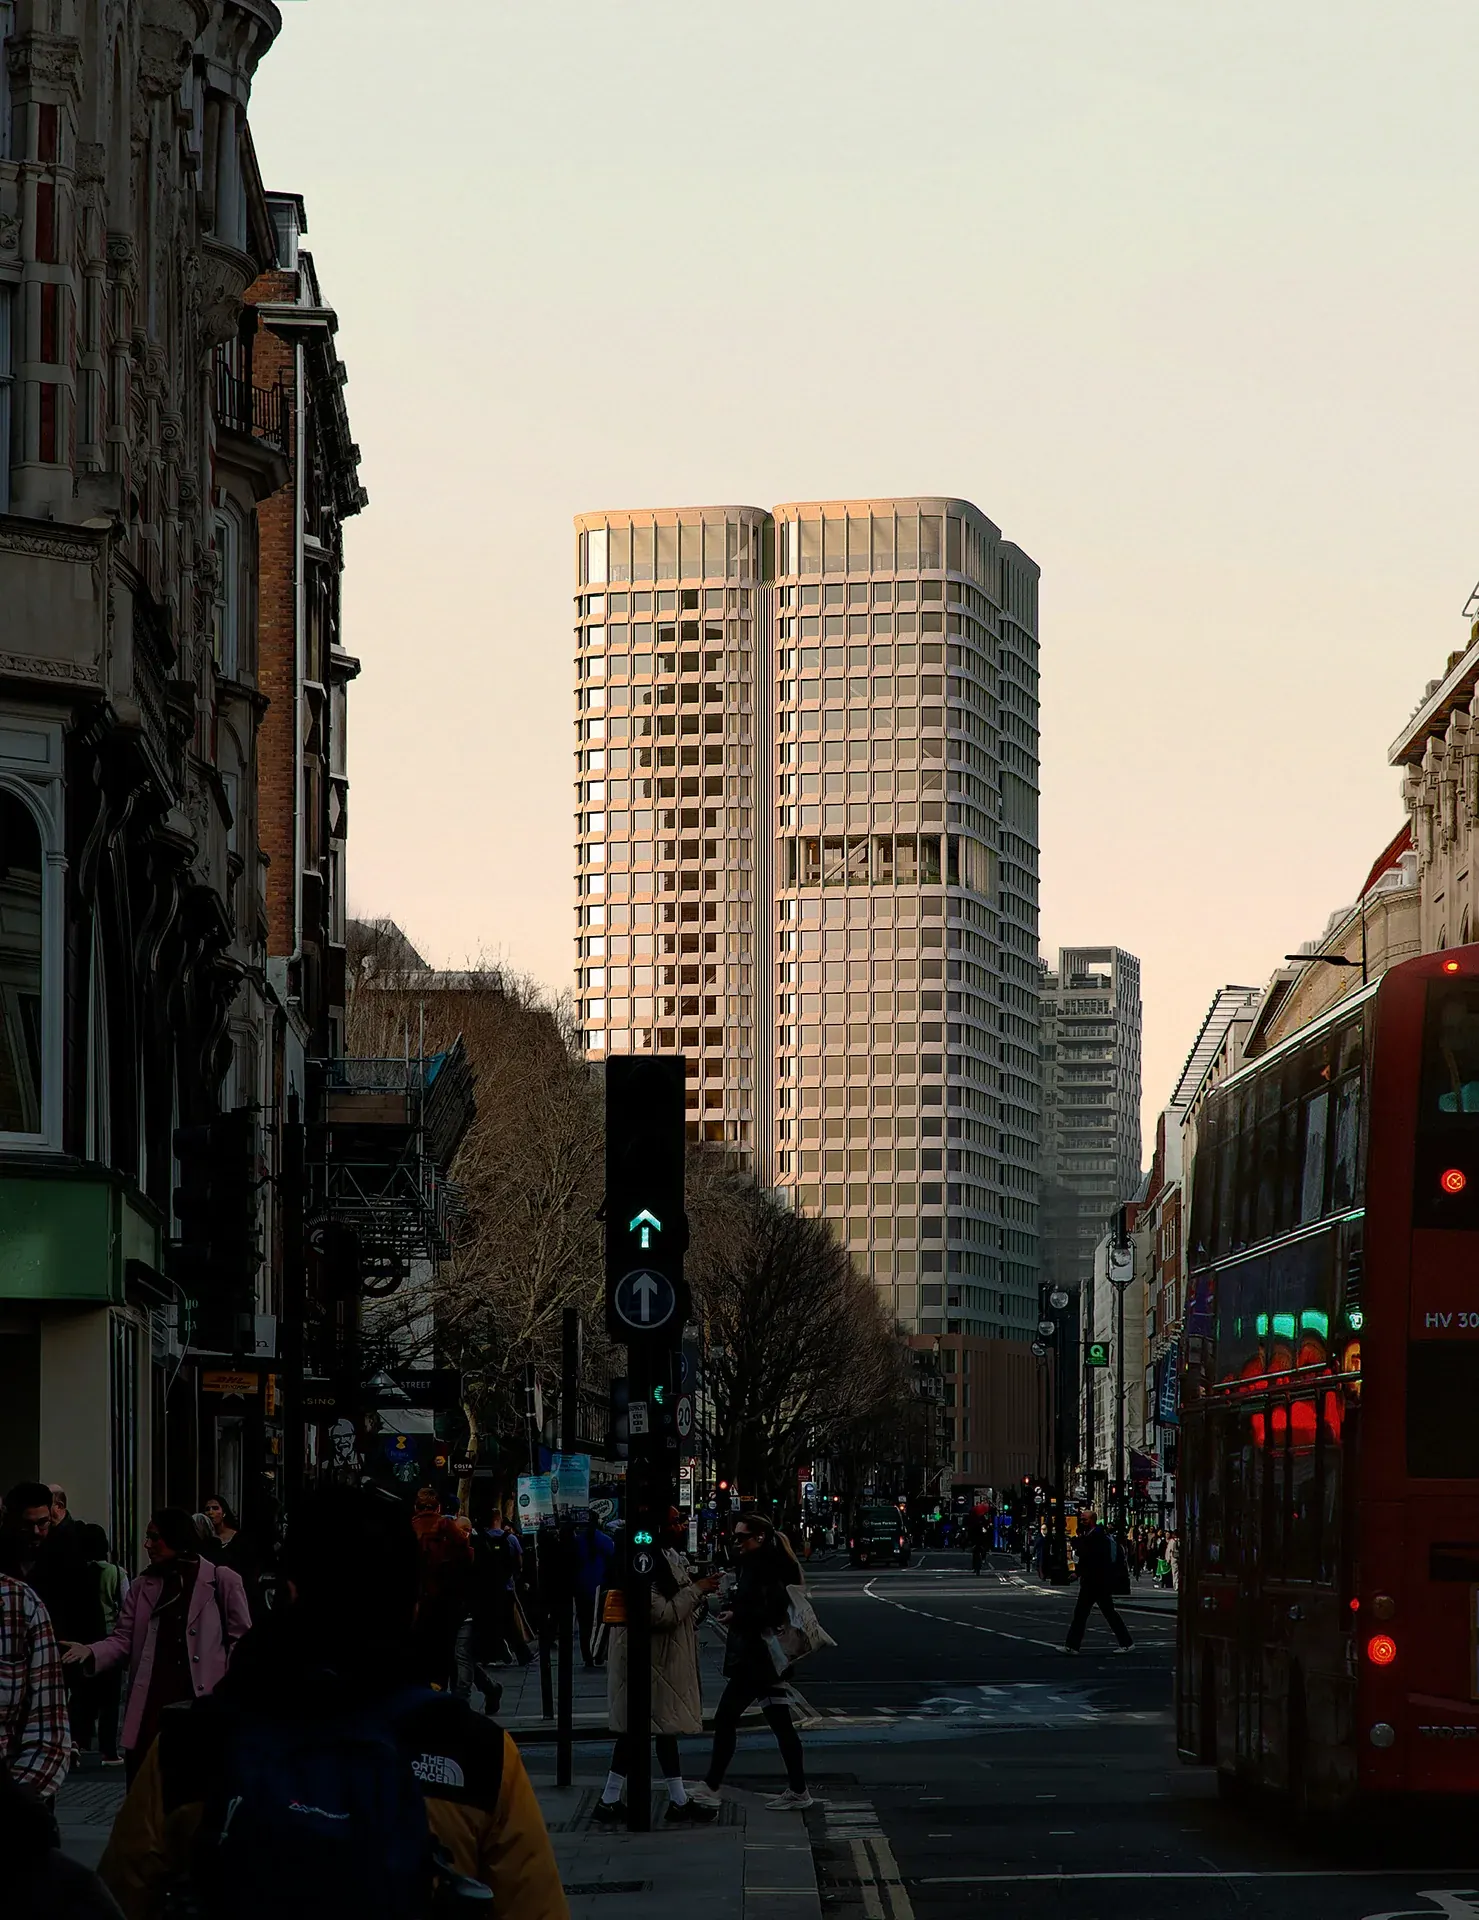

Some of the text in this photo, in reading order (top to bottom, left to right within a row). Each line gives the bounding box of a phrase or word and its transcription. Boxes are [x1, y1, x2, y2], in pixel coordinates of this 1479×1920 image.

[1425, 1312, 1453, 1328] HV
[1090, 1344, 1104, 1358] Q
[400, 1382, 431, 1390] STREET
[303, 1397, 336, 1406] SINO
[678, 1406, 691, 1427] 20
[421, 1753, 444, 1766] THE
[411, 1759, 445, 1775] ORTH
